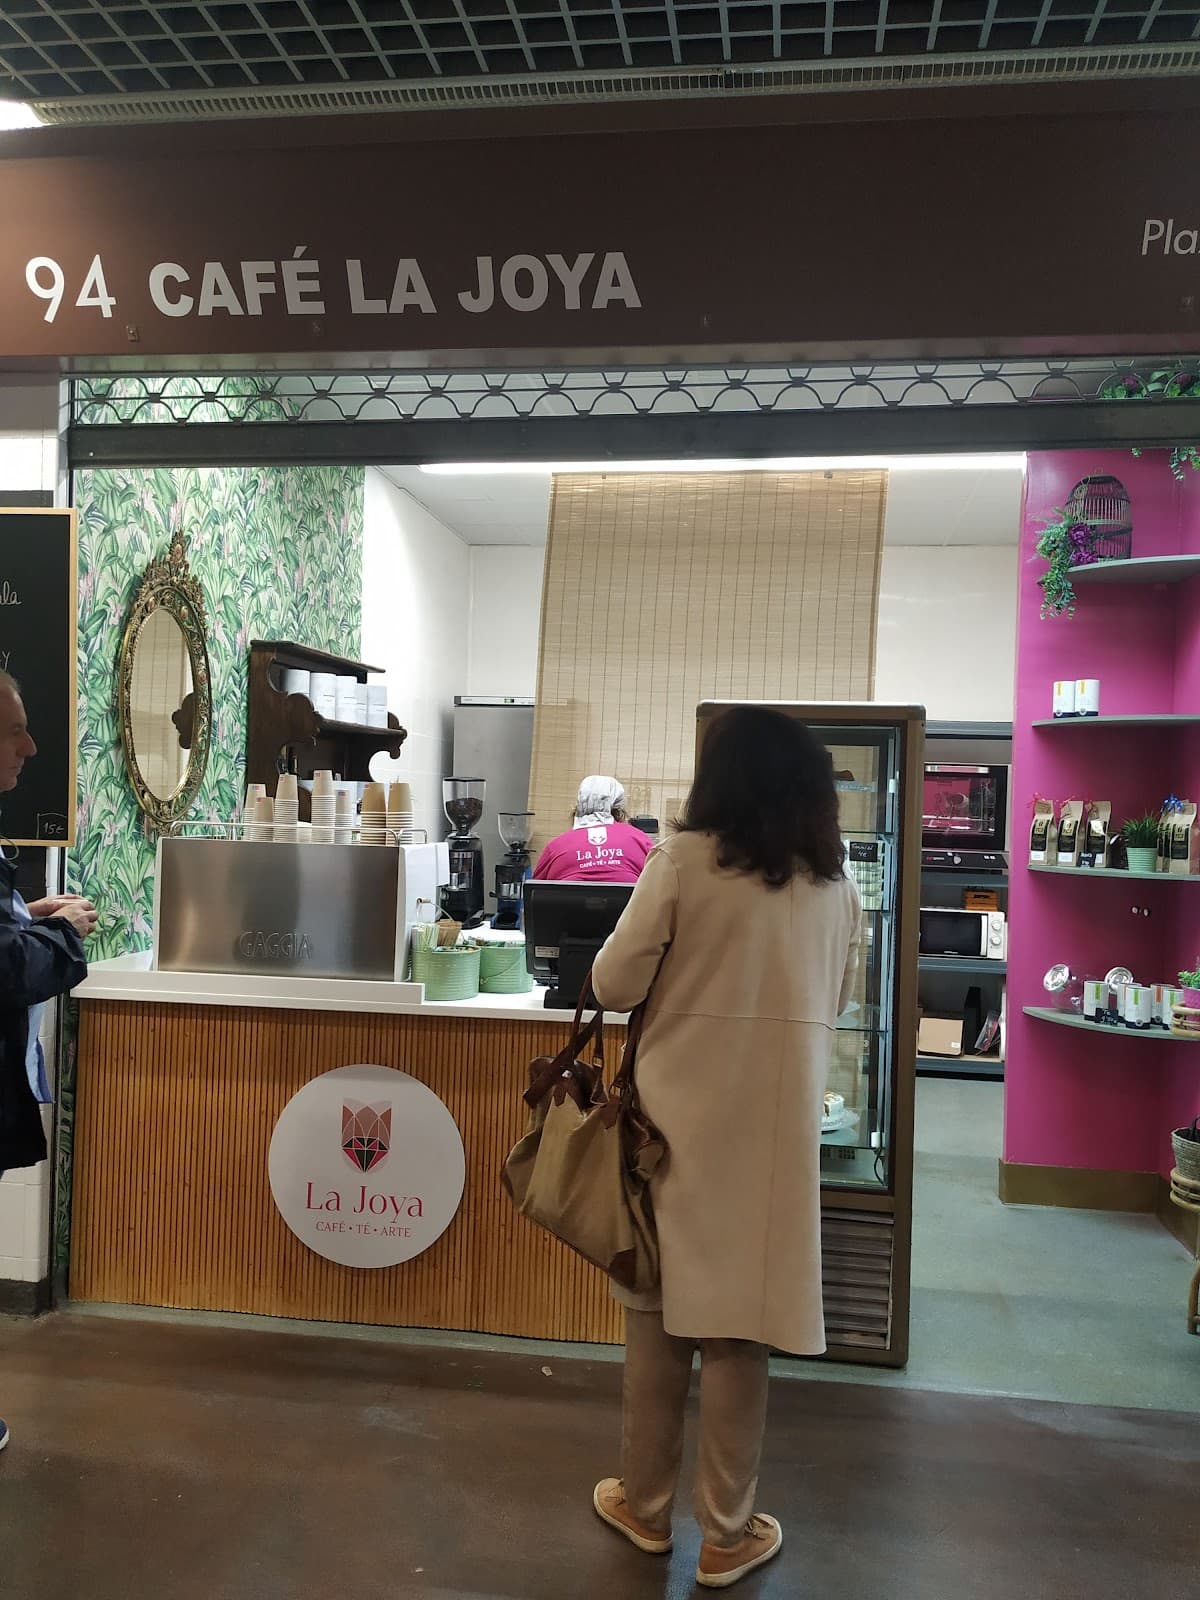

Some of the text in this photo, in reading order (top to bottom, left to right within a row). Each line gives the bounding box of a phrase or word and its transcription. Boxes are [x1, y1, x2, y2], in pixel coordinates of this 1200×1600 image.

[1141, 218, 1200, 256] Pla
[25, 246, 642, 323] 94 CAFÉ LA JOYA
[576, 846, 624, 861] La Joya
[239, 931, 313, 961] GAGGIA
[306, 1182, 424, 1223] La Joya
[316, 1221, 412, 1238] CAFÉ TÉ ARTE
